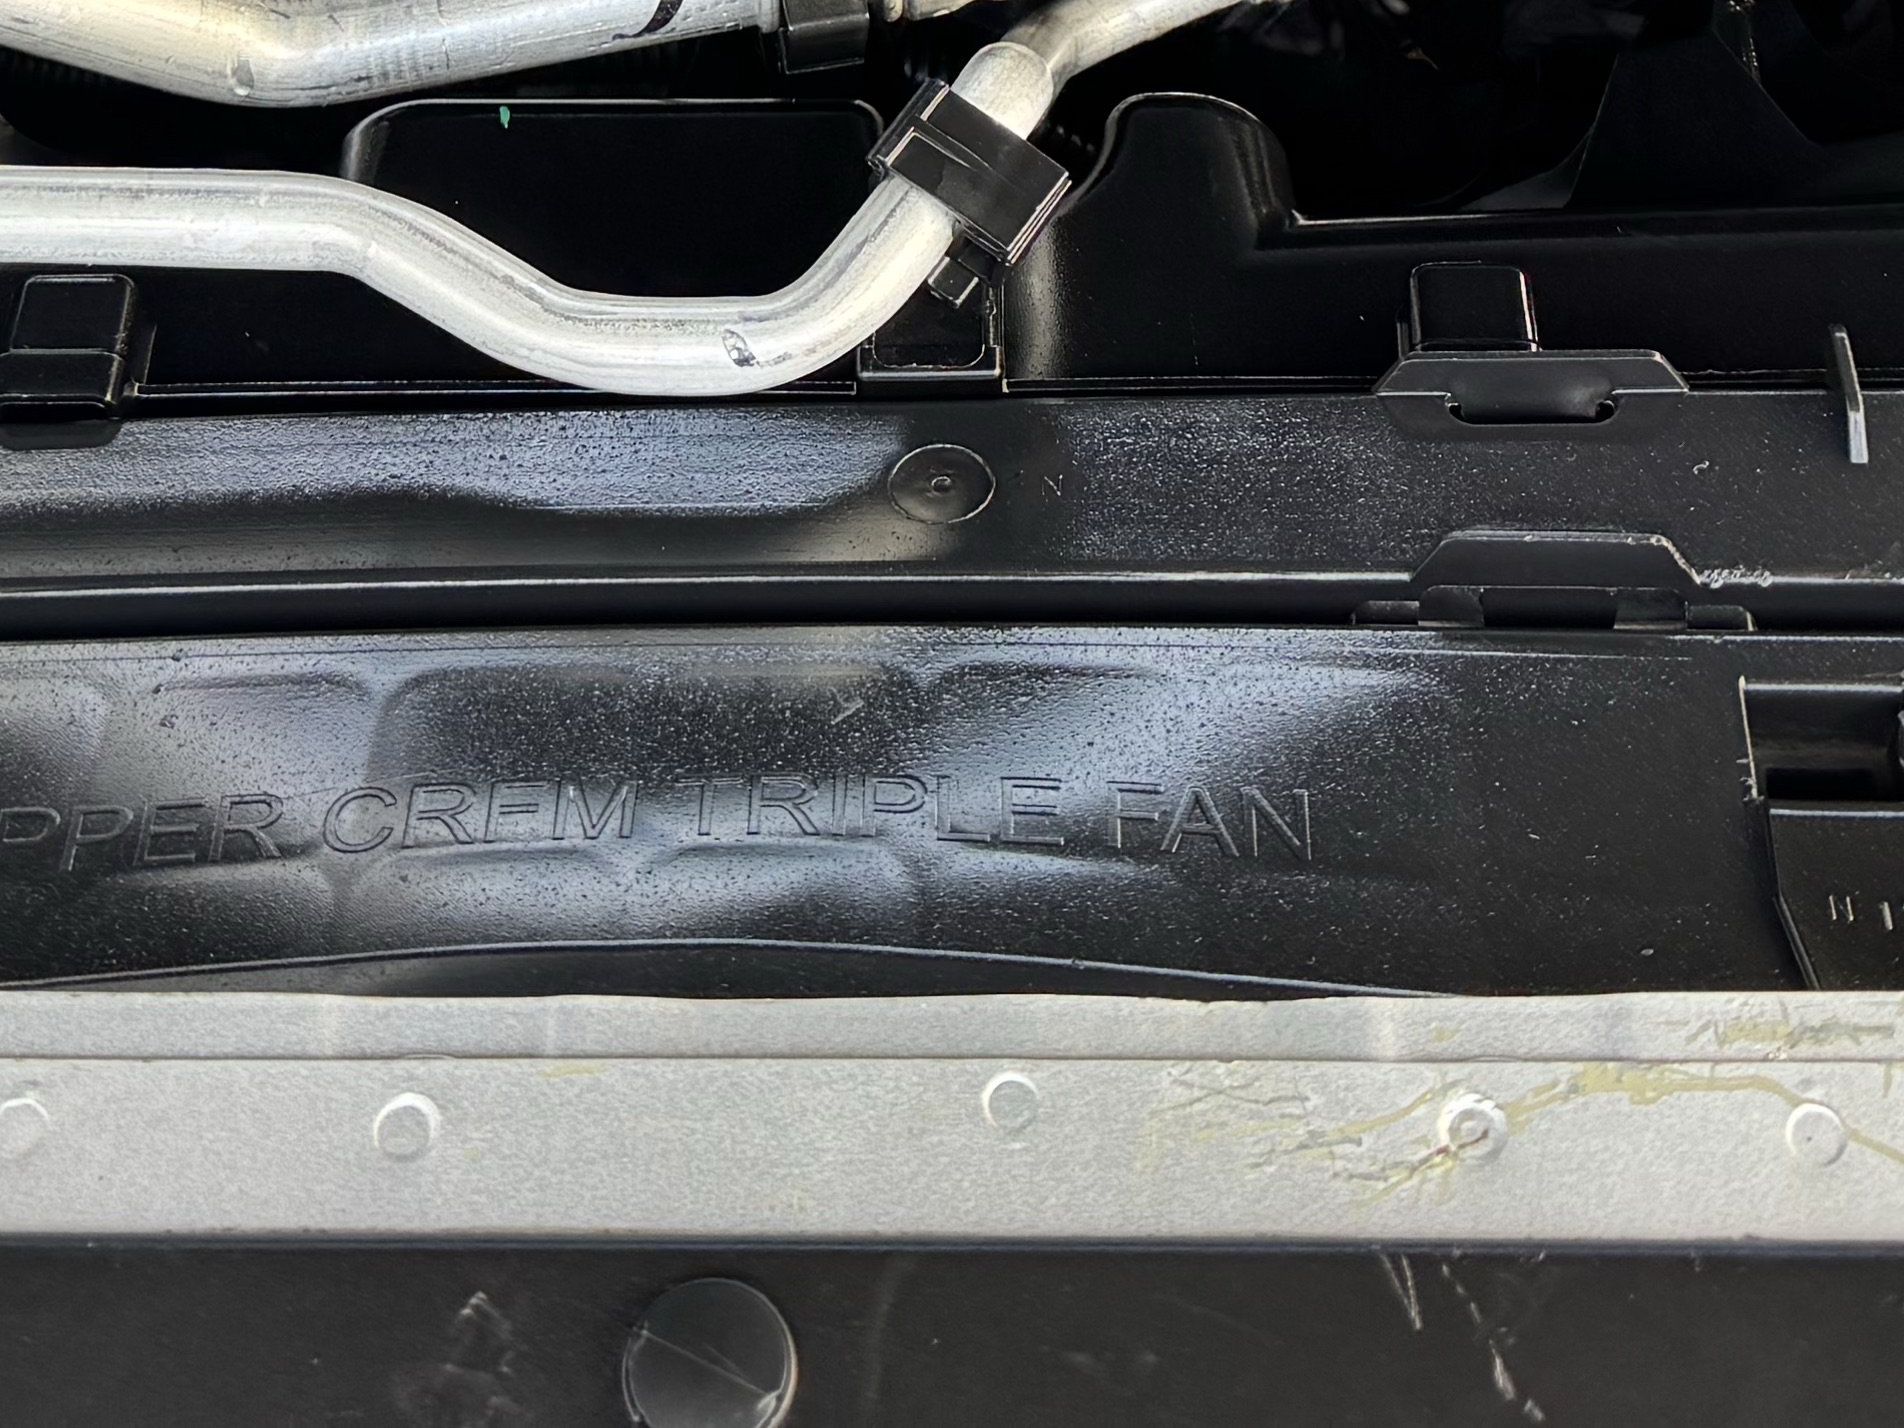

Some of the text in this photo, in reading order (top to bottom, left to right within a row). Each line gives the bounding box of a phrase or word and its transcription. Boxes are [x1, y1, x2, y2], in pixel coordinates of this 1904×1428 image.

[322, 777, 639, 854] CRFM
[672, 772, 1068, 848] TRIPLE
[1108, 778, 1314, 863] FAN
